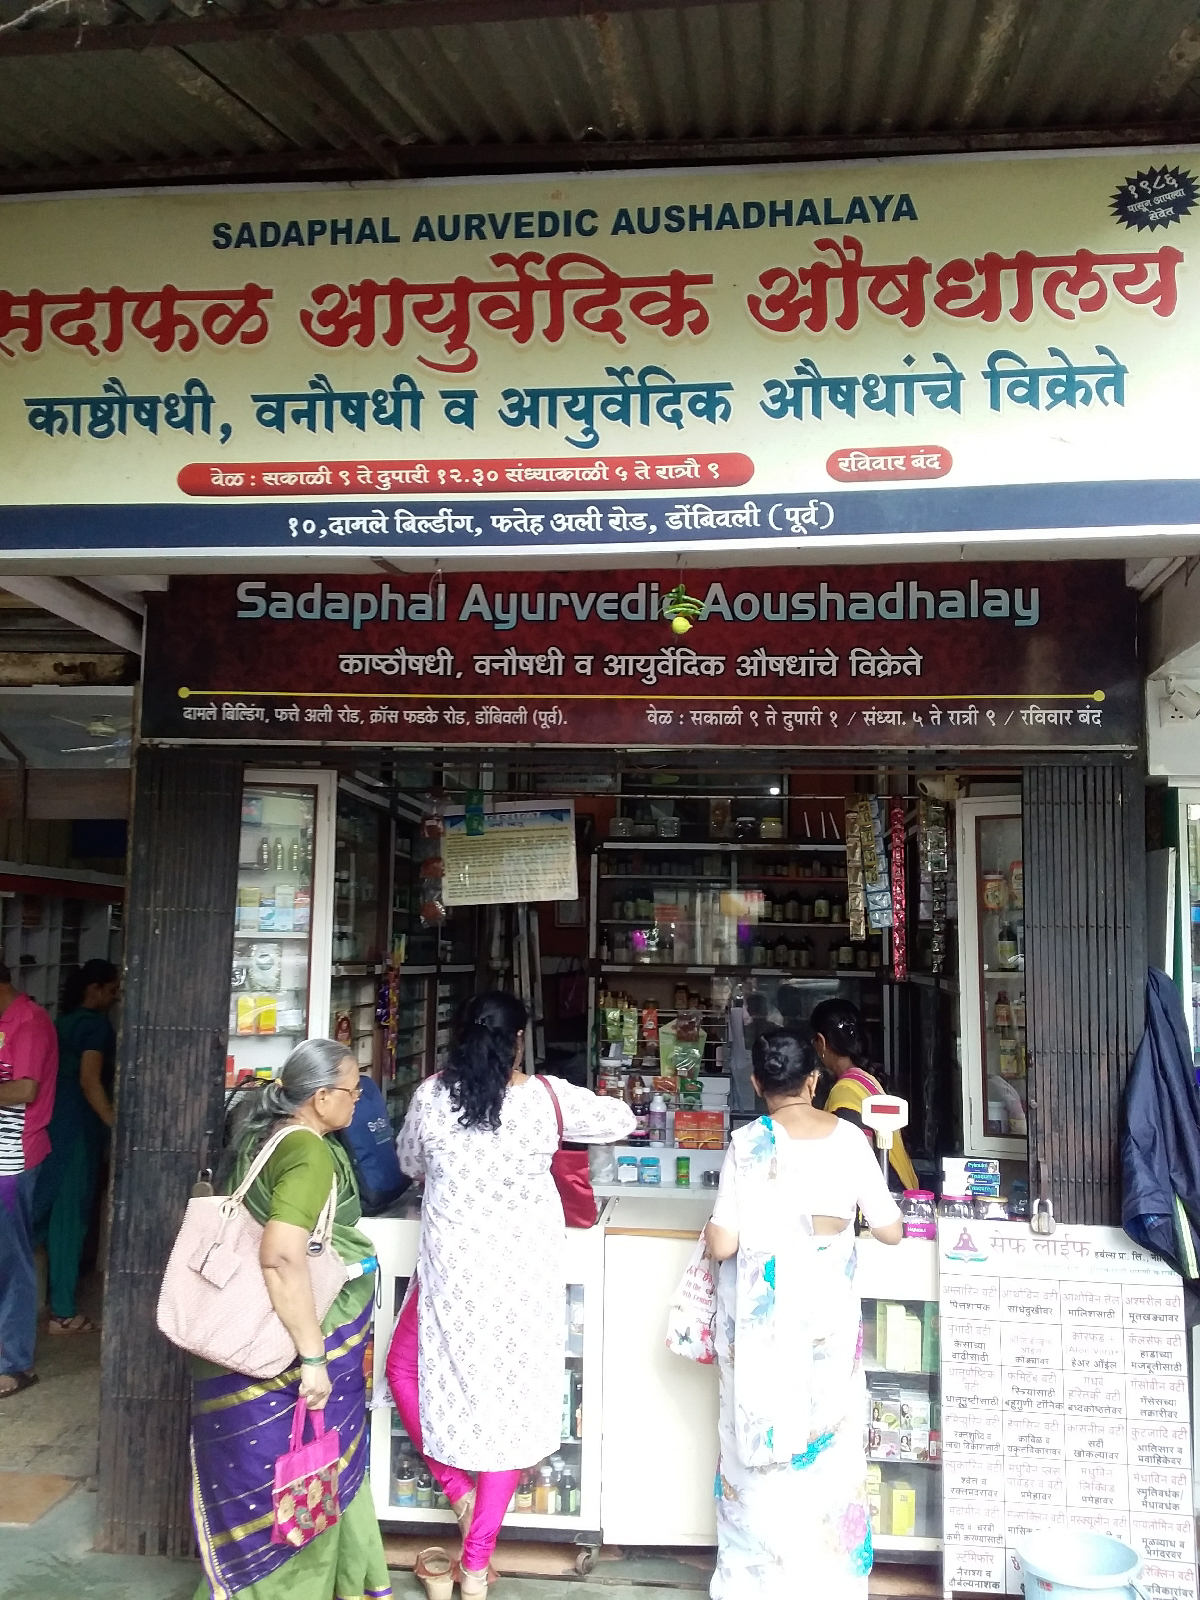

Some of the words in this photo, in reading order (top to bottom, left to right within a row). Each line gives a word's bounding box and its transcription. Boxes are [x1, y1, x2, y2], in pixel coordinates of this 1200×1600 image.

[1128, 173, 1178, 199] १९८६
[212, 216, 400, 250] SADAPHAL
[412, 208, 598, 242] AURVEDIC
[610, 194, 919, 236] AUSHADHALAYA
[1127, 199, 1153, 213] पासून
[1148, 206, 1175, 221] सेवेत
[300, 252, 714, 373] आयुर्वेदिक
[746, 235, 1184, 334] औषधालय
[251, 373, 426, 434] वनौषधी
[439, 389, 479, 430] व
[498, 364, 734, 450] आयुर्वेदिक
[758, 352, 965, 420] औषधांचे
[982, 345, 1129, 412] विक्रेते
[211, 467, 245, 488] वेळ
[262, 465, 333, 486] सकाळी
[340, 469, 351, 486] ९
[356, 465, 373, 485] ते
[377, 463, 430, 491] दुपारी
[437, 468, 499, 485] १२.३०
[505, 456, 609, 484] संध्याकाळी
[616, 466, 627, 482] ५
[634, 459, 651, 481] ते
[708, 462, 720, 480] ९
[837, 452, 905, 474] रविवार
[911, 450, 942, 471] बंद
[490, 506, 545, 535] फतेह
[550, 507, 603, 531] अली
[608, 505, 657, 533] रोड,
[665, 503, 761, 531] डोंबिवली
[768, 499, 836, 535] (पूर्व)
[236, 581, 446, 630] Sadaphal
[699, 579, 1041, 627] Aoushadhalay
[473, 646, 564, 677] वनौषधी
[574, 654, 594, 675] व
[602, 647, 726, 685] आयुर्वेदिक
[735, 647, 839, 677] औषधांचे
[849, 646, 924, 677] विक्रेते
[183, 704, 219, 721] दामले
[274, 705, 300, 723] फत्ते
[304, 705, 332, 724] अली
[338, 705, 365, 725] रोड,
[369, 704, 399, 725] क्रॉस
[403, 705, 439, 725] फडके
[443, 706, 470, 727] रोड,
[475, 705, 528, 725] डोंबिवली
[647, 704, 673, 724] वेळ
[690, 704, 743, 726] सकाळी
[750, 711, 759, 727] ९
[765, 705, 778, 726] ते
[783, 705, 824, 731] दुपारी
[830, 711, 838, 727] १
[913, 711, 924, 728] ५
[929, 704, 942, 727] ते
[948, 704, 979, 727] रात्री
[986, 711, 996, 728] ९
[1021, 704, 1072, 727] रविवार
[1077, 704, 1103, 728] बंद
[989, 1230, 1027, 1254] सेफ
[1033, 1234, 1091, 1260] लाईफ
